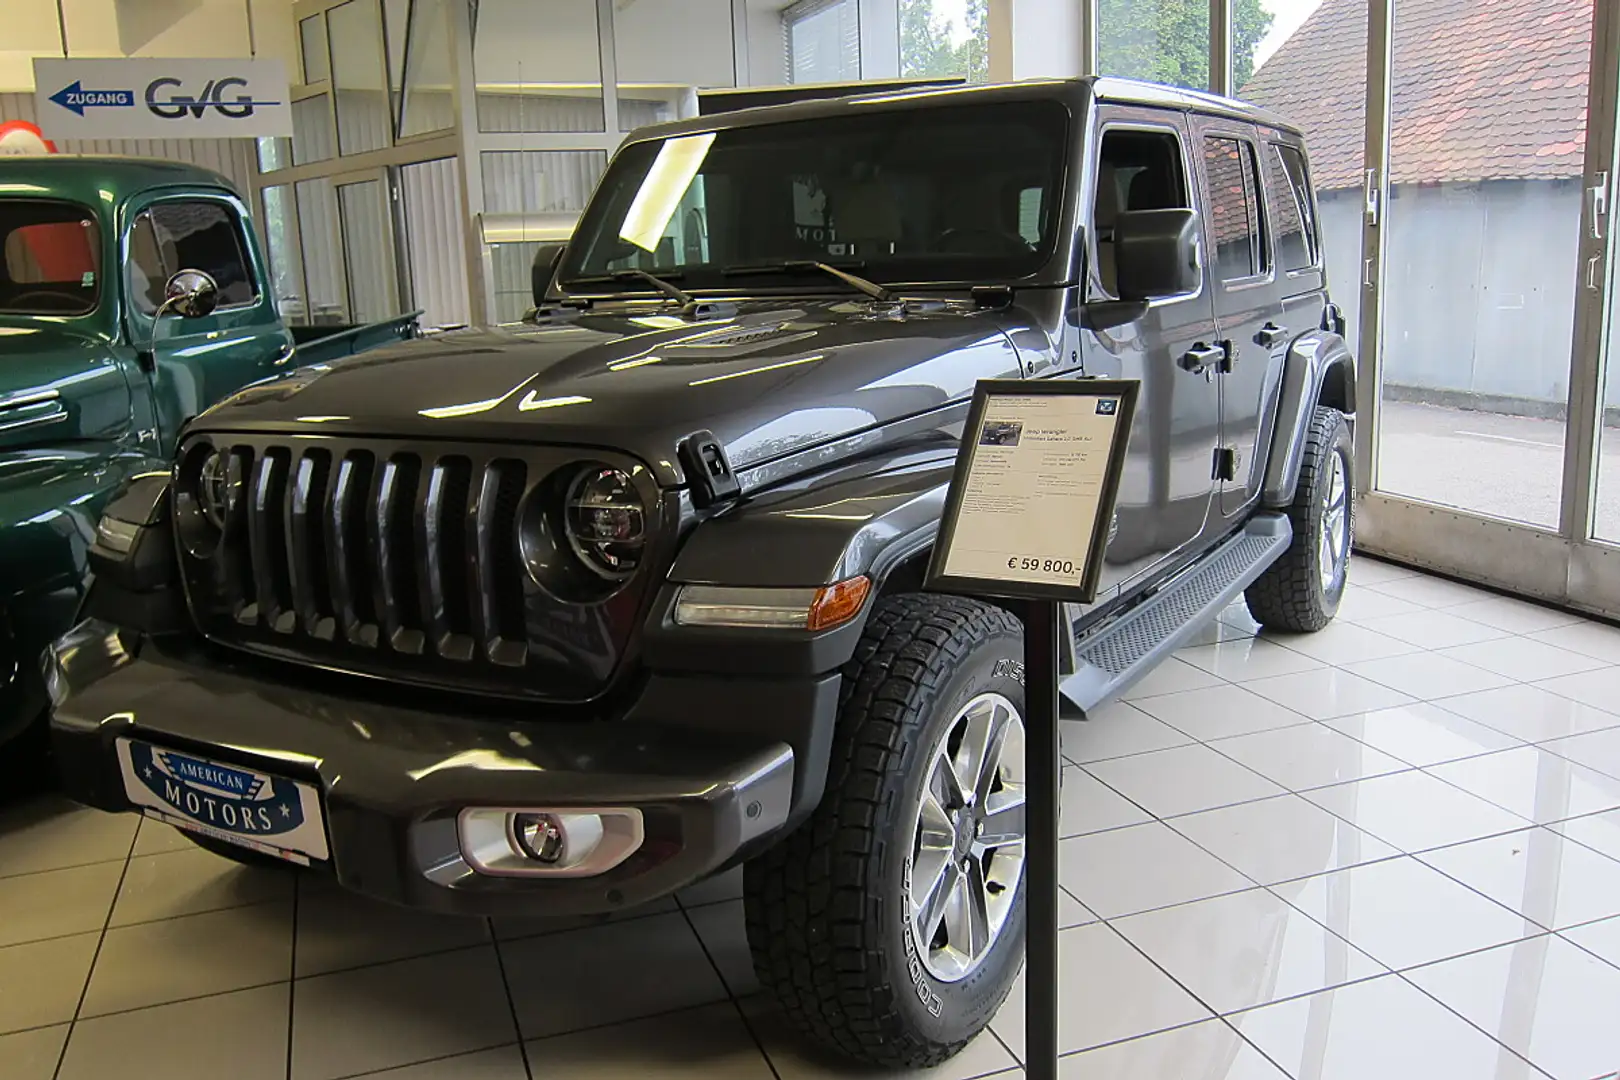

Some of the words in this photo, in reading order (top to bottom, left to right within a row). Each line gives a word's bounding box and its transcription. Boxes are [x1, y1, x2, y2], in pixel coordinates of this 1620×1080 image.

[66, 93, 128, 105] ZUGANG
[1008, 557, 1018, 569] €
[1021, 558, 1040, 571] 59
[1043, 559, 1082, 575] 800,-
[179, 761, 244, 790] AMERICAN
[164, 779, 272, 831] MOTORS
